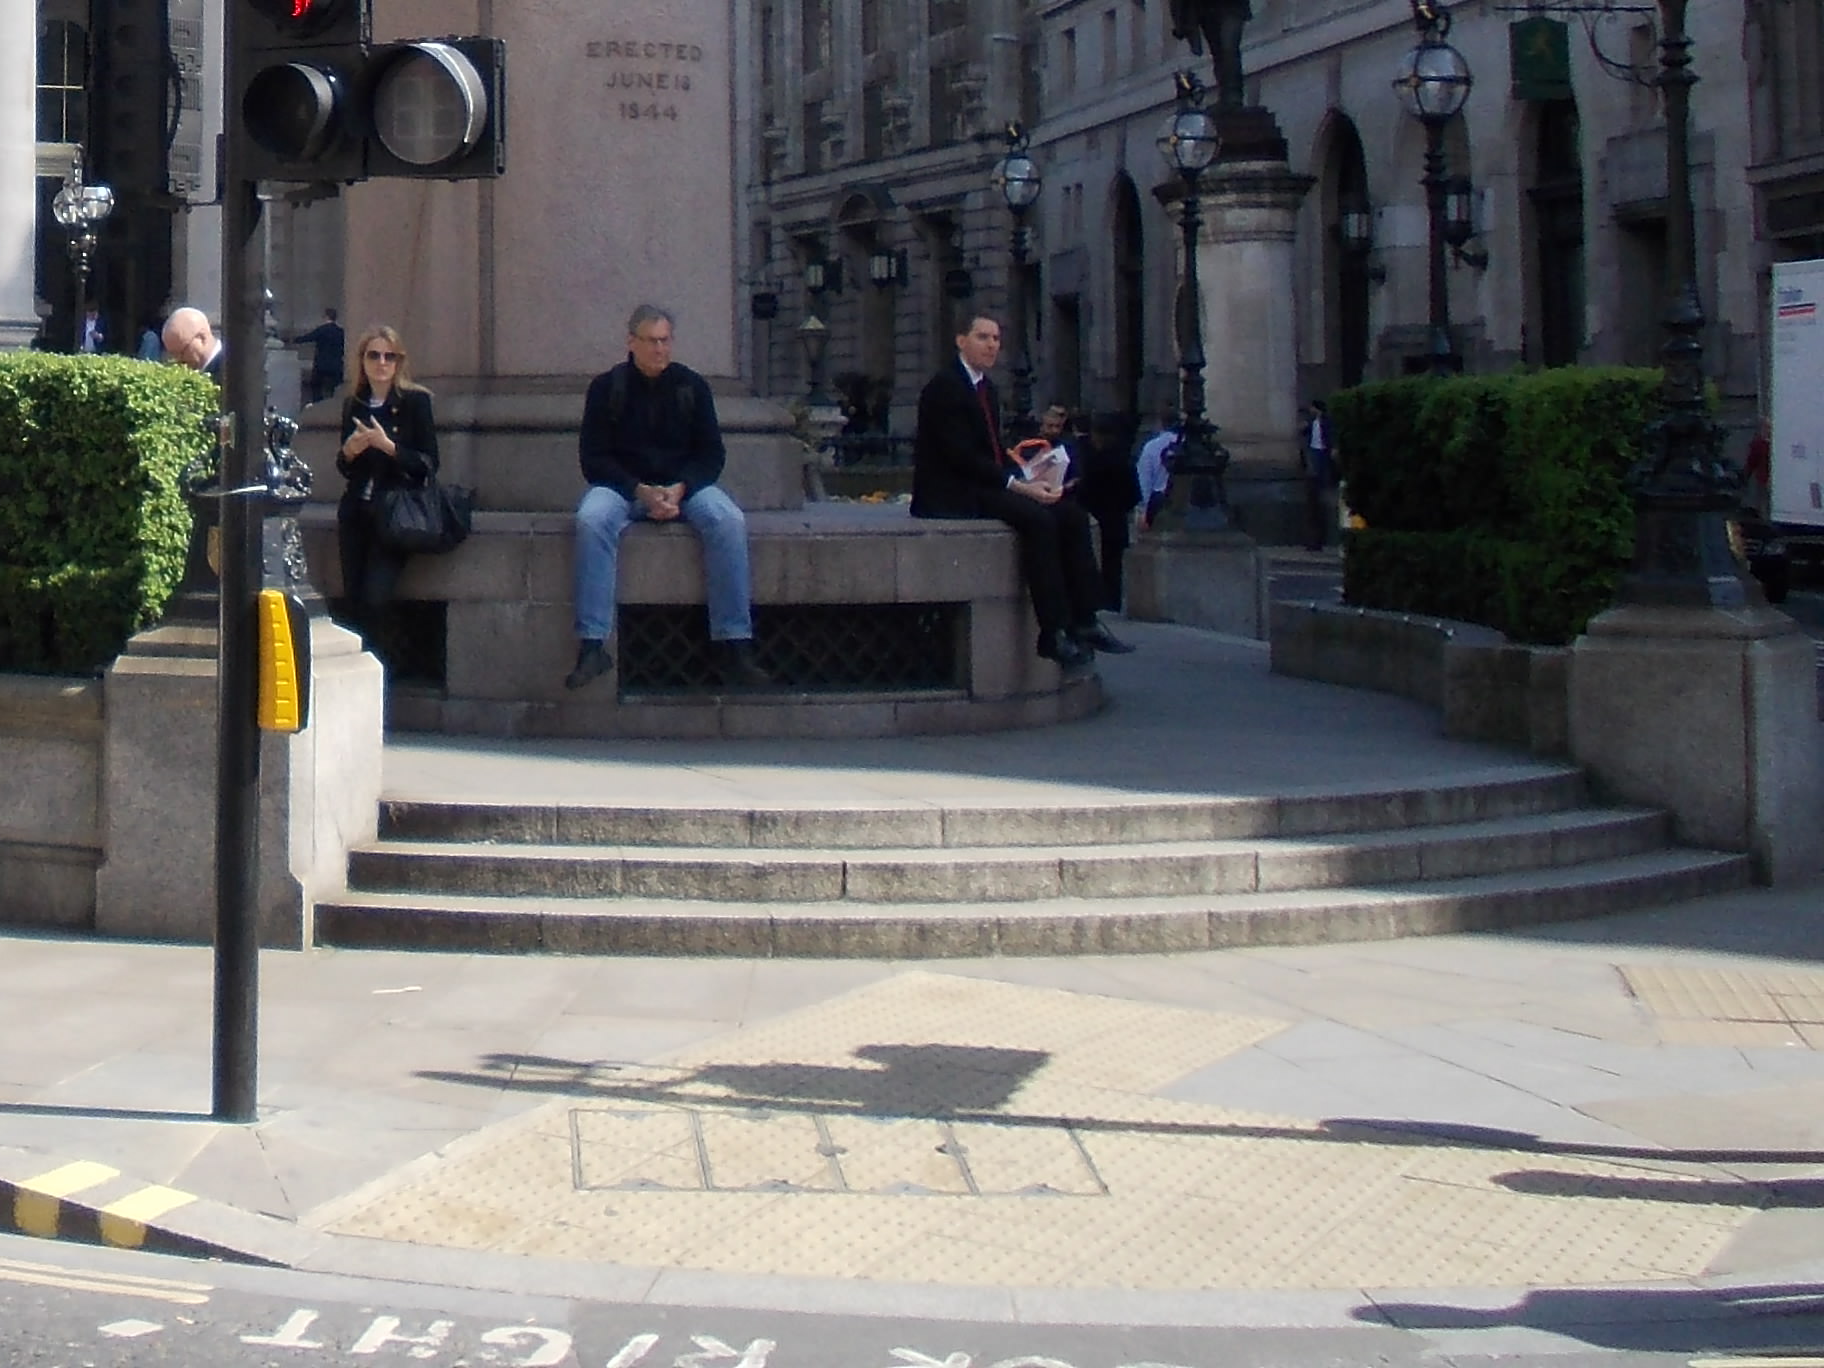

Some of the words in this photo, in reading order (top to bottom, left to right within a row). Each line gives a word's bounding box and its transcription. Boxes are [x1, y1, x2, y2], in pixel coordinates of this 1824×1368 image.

[585, 40, 703, 62] ERECTED
[605, 72, 670, 91] JUNE
[618, 101, 679, 121] 1844
